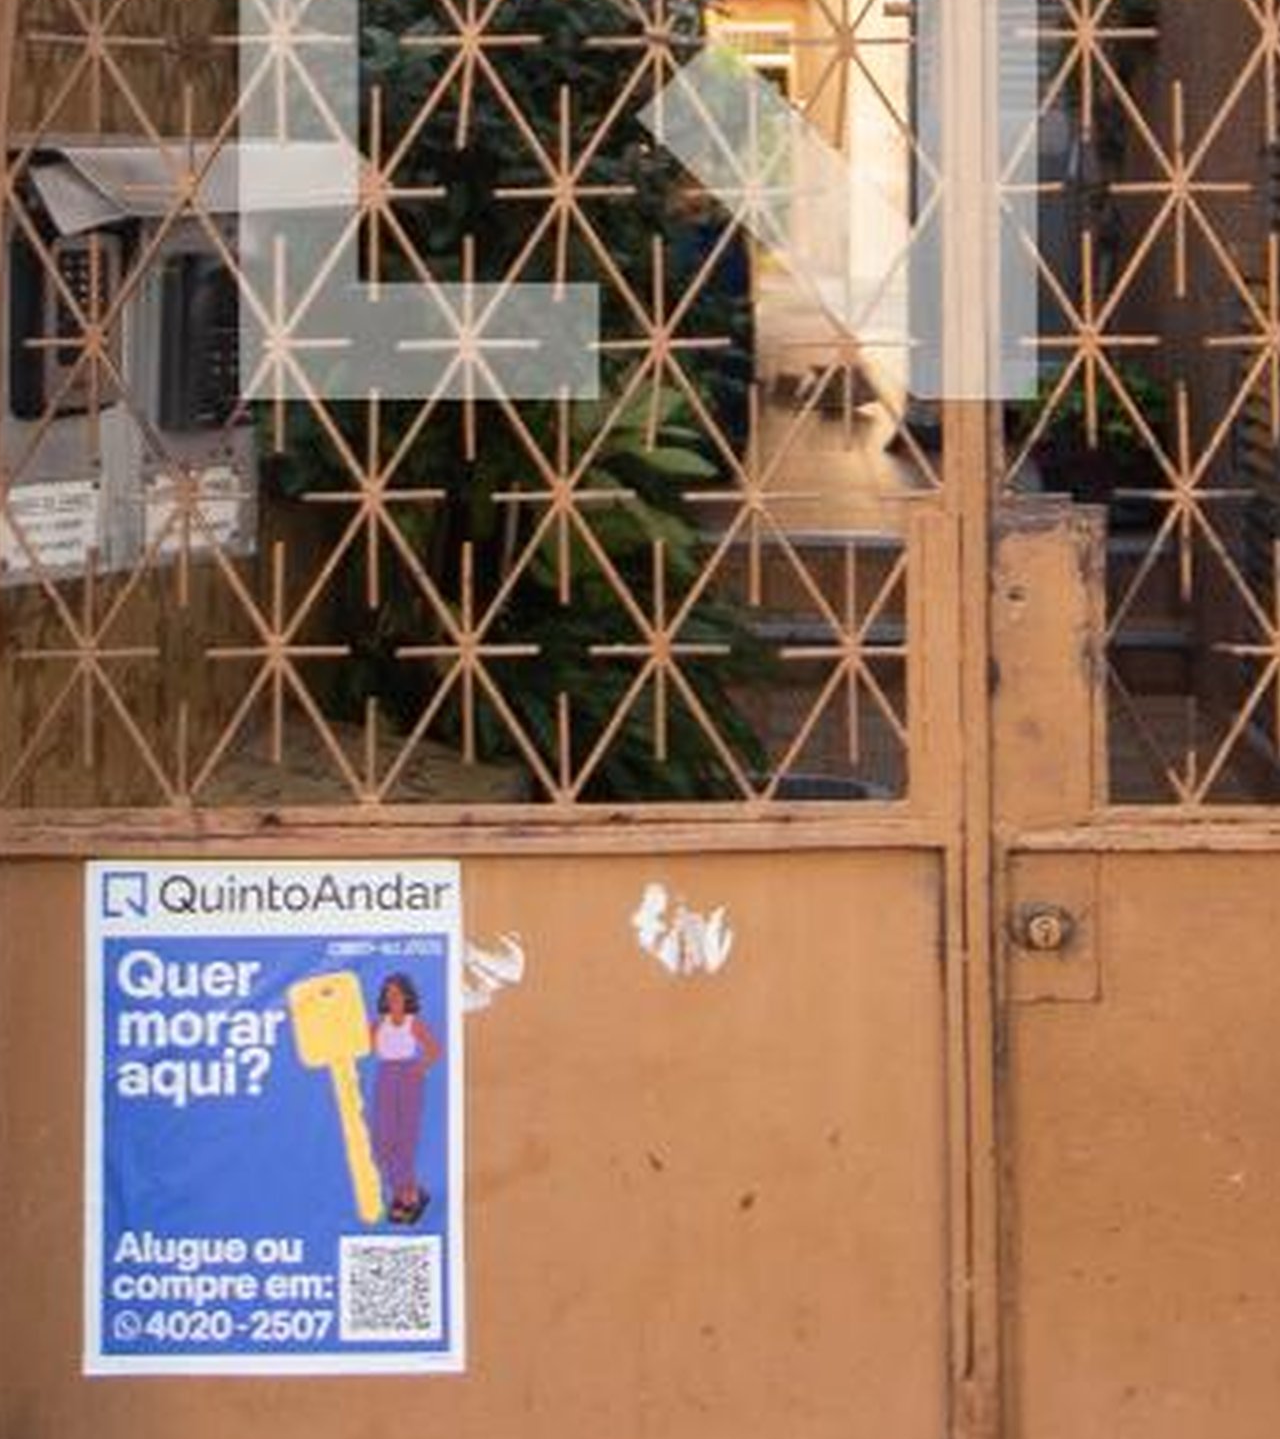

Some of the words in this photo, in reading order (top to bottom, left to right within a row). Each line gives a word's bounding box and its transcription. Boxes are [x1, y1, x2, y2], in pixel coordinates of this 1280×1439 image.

[158, 872, 451, 914] QuintoAndar
[117, 950, 261, 1000] Quer
[117, 1009, 287, 1047] morar
[117, 1048, 271, 1107] aqui?
[113, 1231, 248, 1271] Alugue
[254, 1237, 303, 1263] ou
[111, 1273, 258, 1306] compre
[265, 1274, 334, 1301] em:
[144, 1308, 334, 1342] 4020-2507
